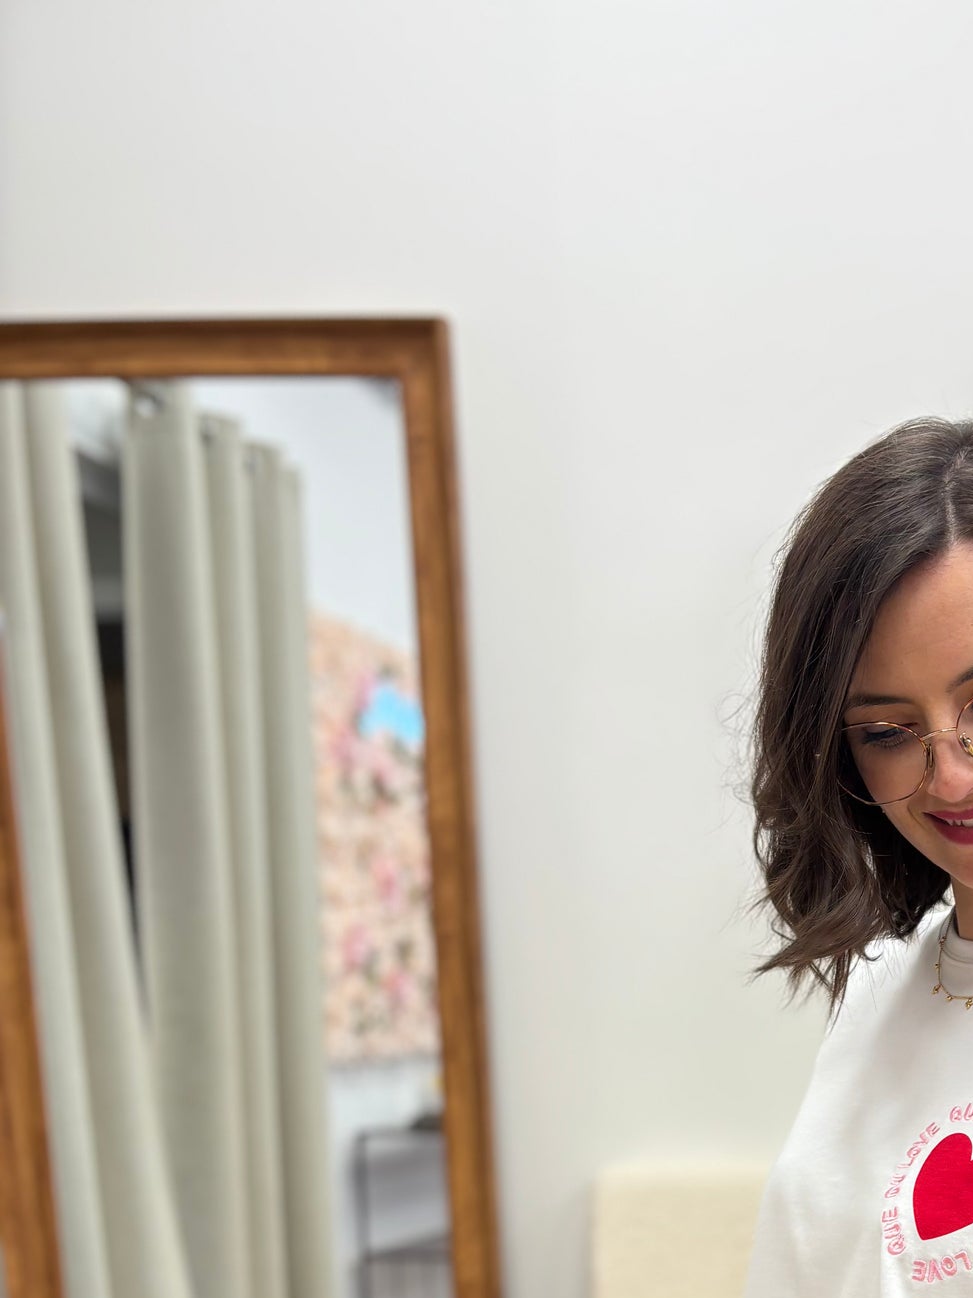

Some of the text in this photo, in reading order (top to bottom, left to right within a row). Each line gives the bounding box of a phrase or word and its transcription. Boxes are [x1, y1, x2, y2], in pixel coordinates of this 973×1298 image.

[882, 1206, 906, 1256] QUE
[897, 1121, 941, 1168] LOVE
[911, 1251, 972, 1283] LOVE
